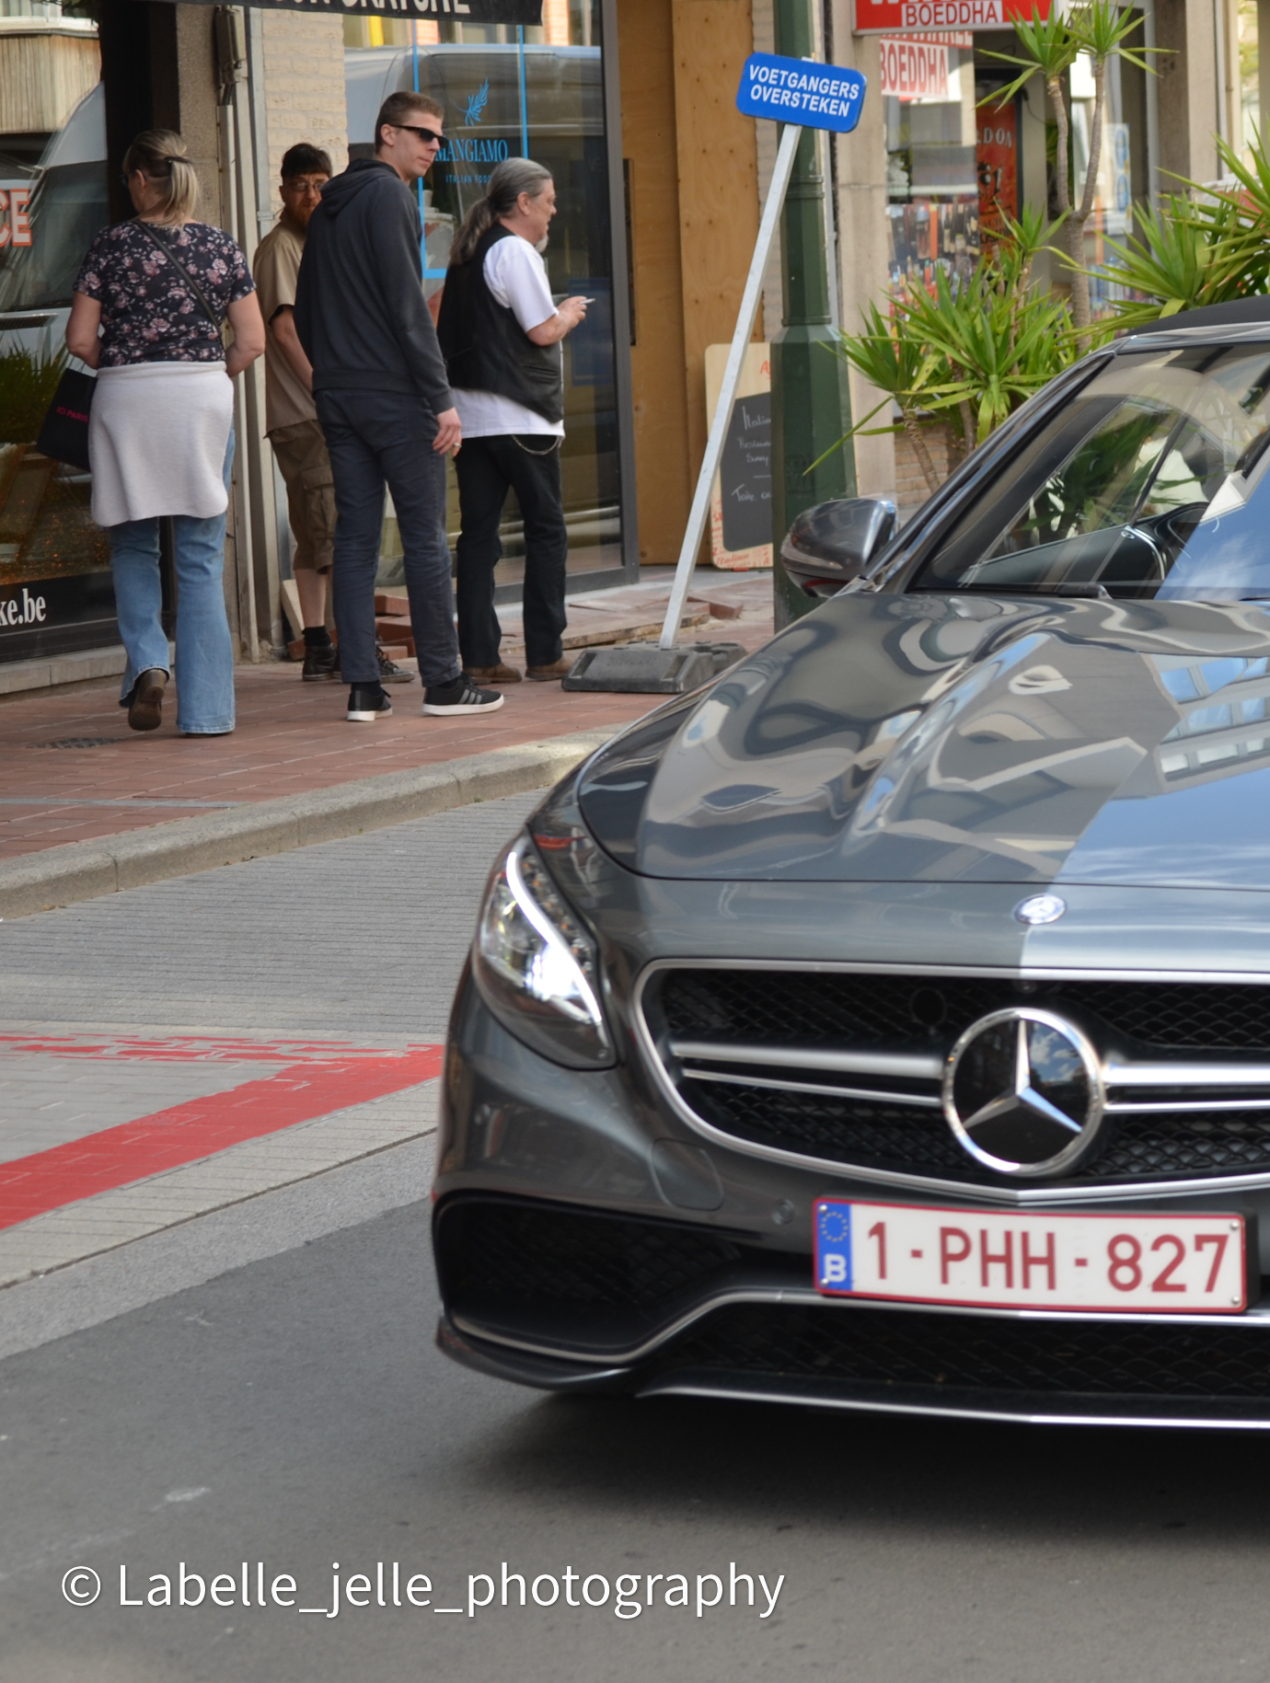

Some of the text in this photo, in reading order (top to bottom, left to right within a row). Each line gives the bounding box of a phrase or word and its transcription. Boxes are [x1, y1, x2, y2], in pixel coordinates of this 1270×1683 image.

[905, 2, 998, 26] BOEDDHA
[749, 64, 860, 100] VOETGANGERS
[880, 43, 948, 95] BOEDDHA
[750, 84, 850, 117] OVERSTEKEN
[446, 174, 473, 184] ITALIAN
[824, 1221, 1230, 1293] B 1-PHH-827
